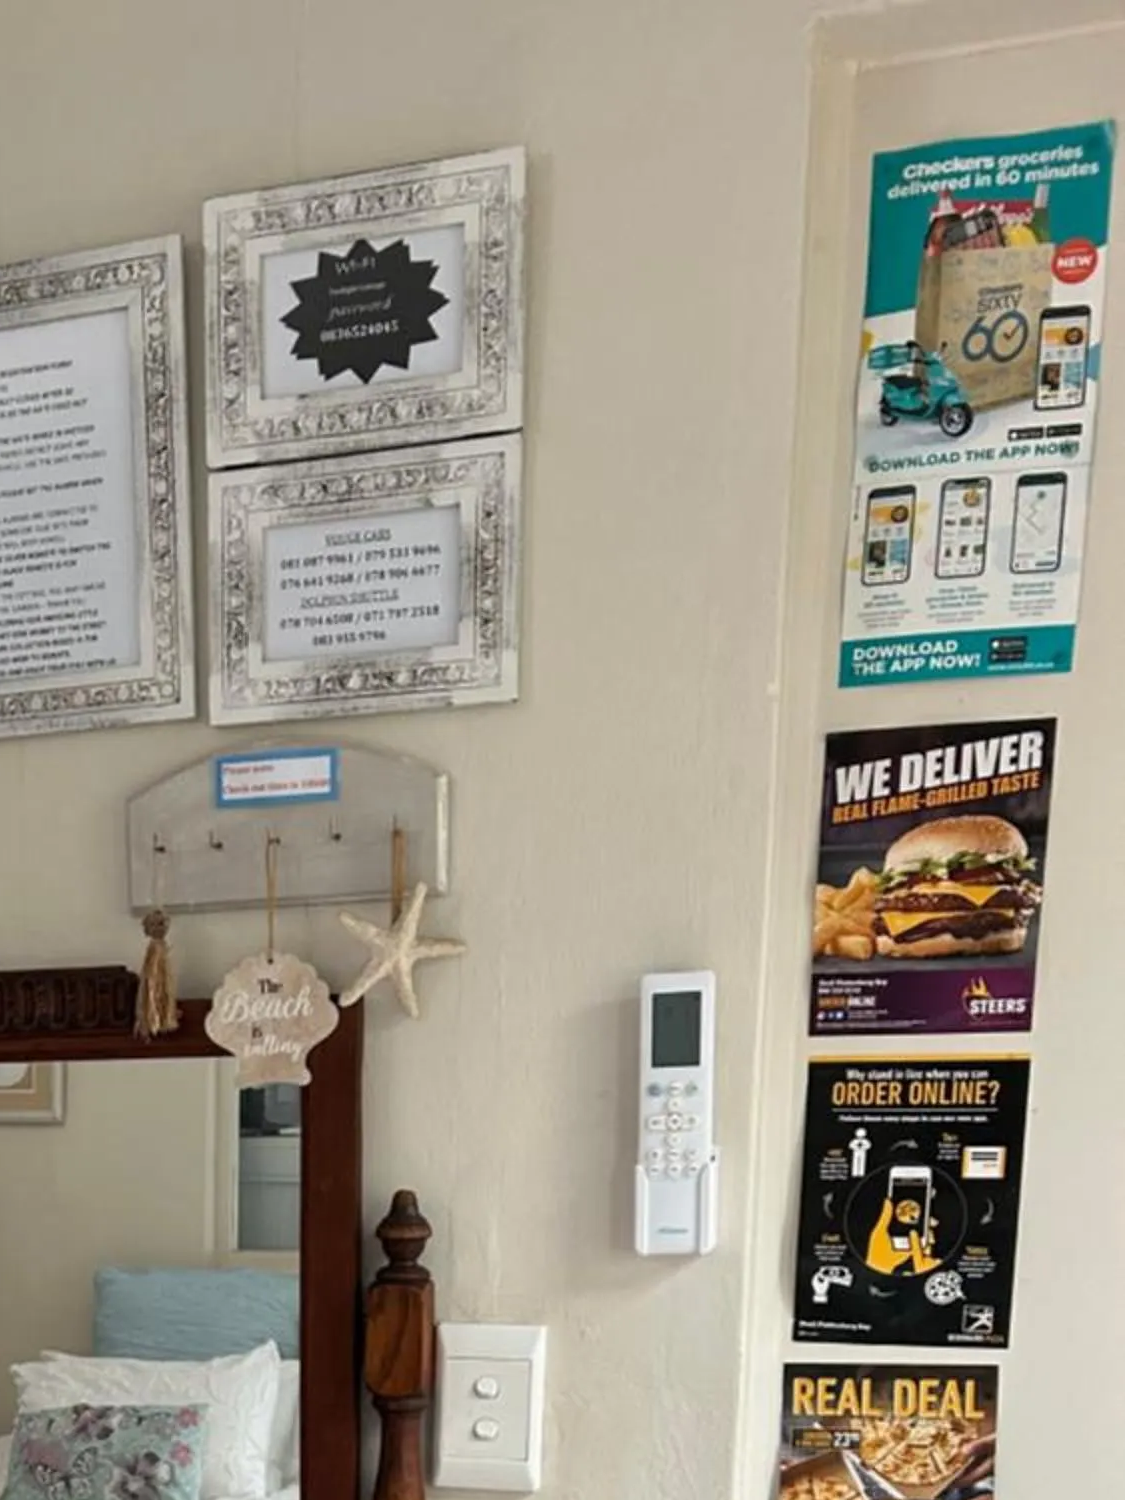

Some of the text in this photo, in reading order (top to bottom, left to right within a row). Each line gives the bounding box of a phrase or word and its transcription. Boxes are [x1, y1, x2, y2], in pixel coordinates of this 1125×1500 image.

[903, 144, 1083, 180] Checkers groceries
[887, 161, 1100, 200] delivered in 60 minutes
[1056, 256, 1093, 269] NEW
[868, 450, 960, 473] DOWNLOAD
[965, 447, 996, 461] THE
[999, 444, 1031, 458] APP
[853, 640, 958, 661] DOWNLOAD
[853, 661, 886, 676] THE
[889, 657, 925, 673] APP
[929, 653, 982, 670] NOW!
[835, 730, 1045, 804] WE DELIVER
[832, 771, 1040, 824] REAL FLAME-GRILLED TASTE
[257, 978, 284, 995] The
[220, 985, 314, 1023] Beach
[970, 997, 1026, 1015] STEERS
[832, 1080, 1001, 1106] ORDER ONLINE?
[792, 1377, 985, 1419] REAL DEAL
